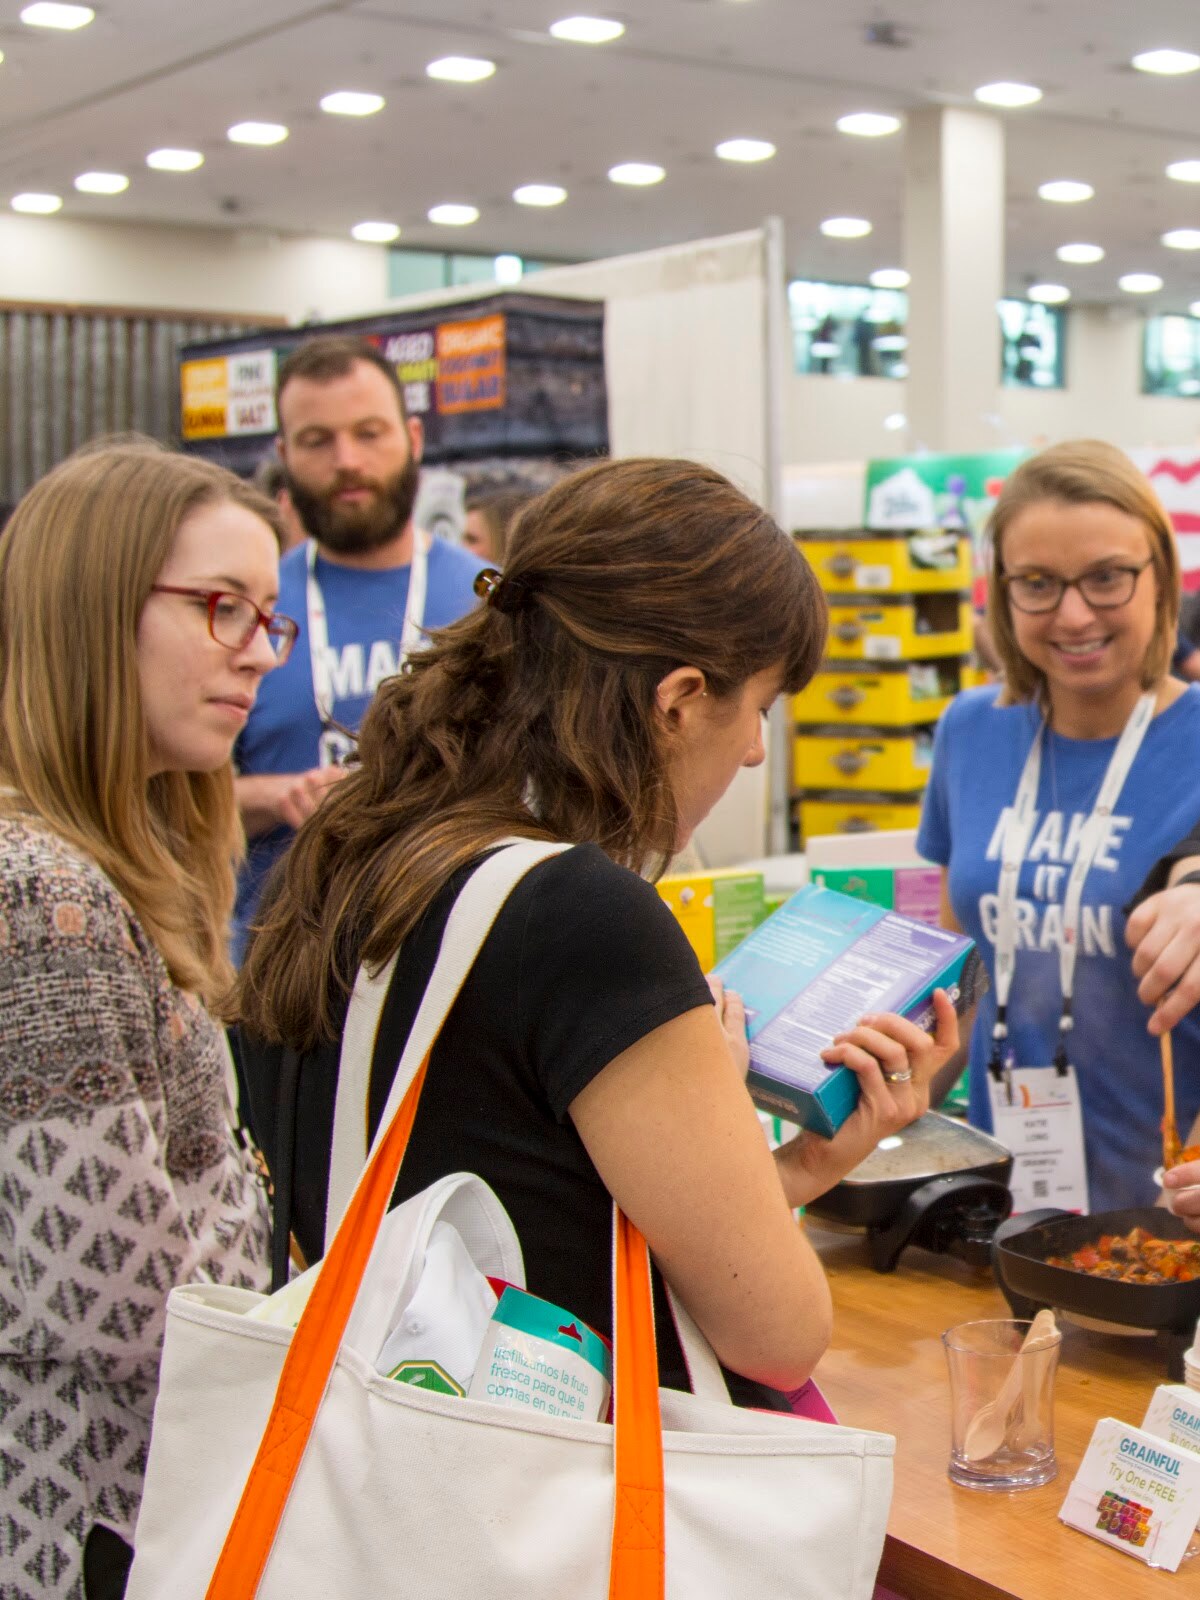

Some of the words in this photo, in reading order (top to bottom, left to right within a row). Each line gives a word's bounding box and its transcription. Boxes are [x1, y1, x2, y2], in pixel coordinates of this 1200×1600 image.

[1034, 864, 1065, 902] IT
[487, 1383, 530, 1404] comas
[532, 1397, 546, 1411] en
[548, 1404, 560, 1417] su
[490, 1362, 530, 1386] fresca
[532, 1379, 556, 1397] para
[557, 1390, 576, 1407] que
[577, 1397, 585, 1412] la
[571, 1375, 589, 1396] fruta
[1119, 1438, 1181, 1476] GRAINFUL
[1108, 1462, 1124, 1481] Try
[1125, 1470, 1147, 1489] One
[1147, 1480, 1177, 1503] FREE
